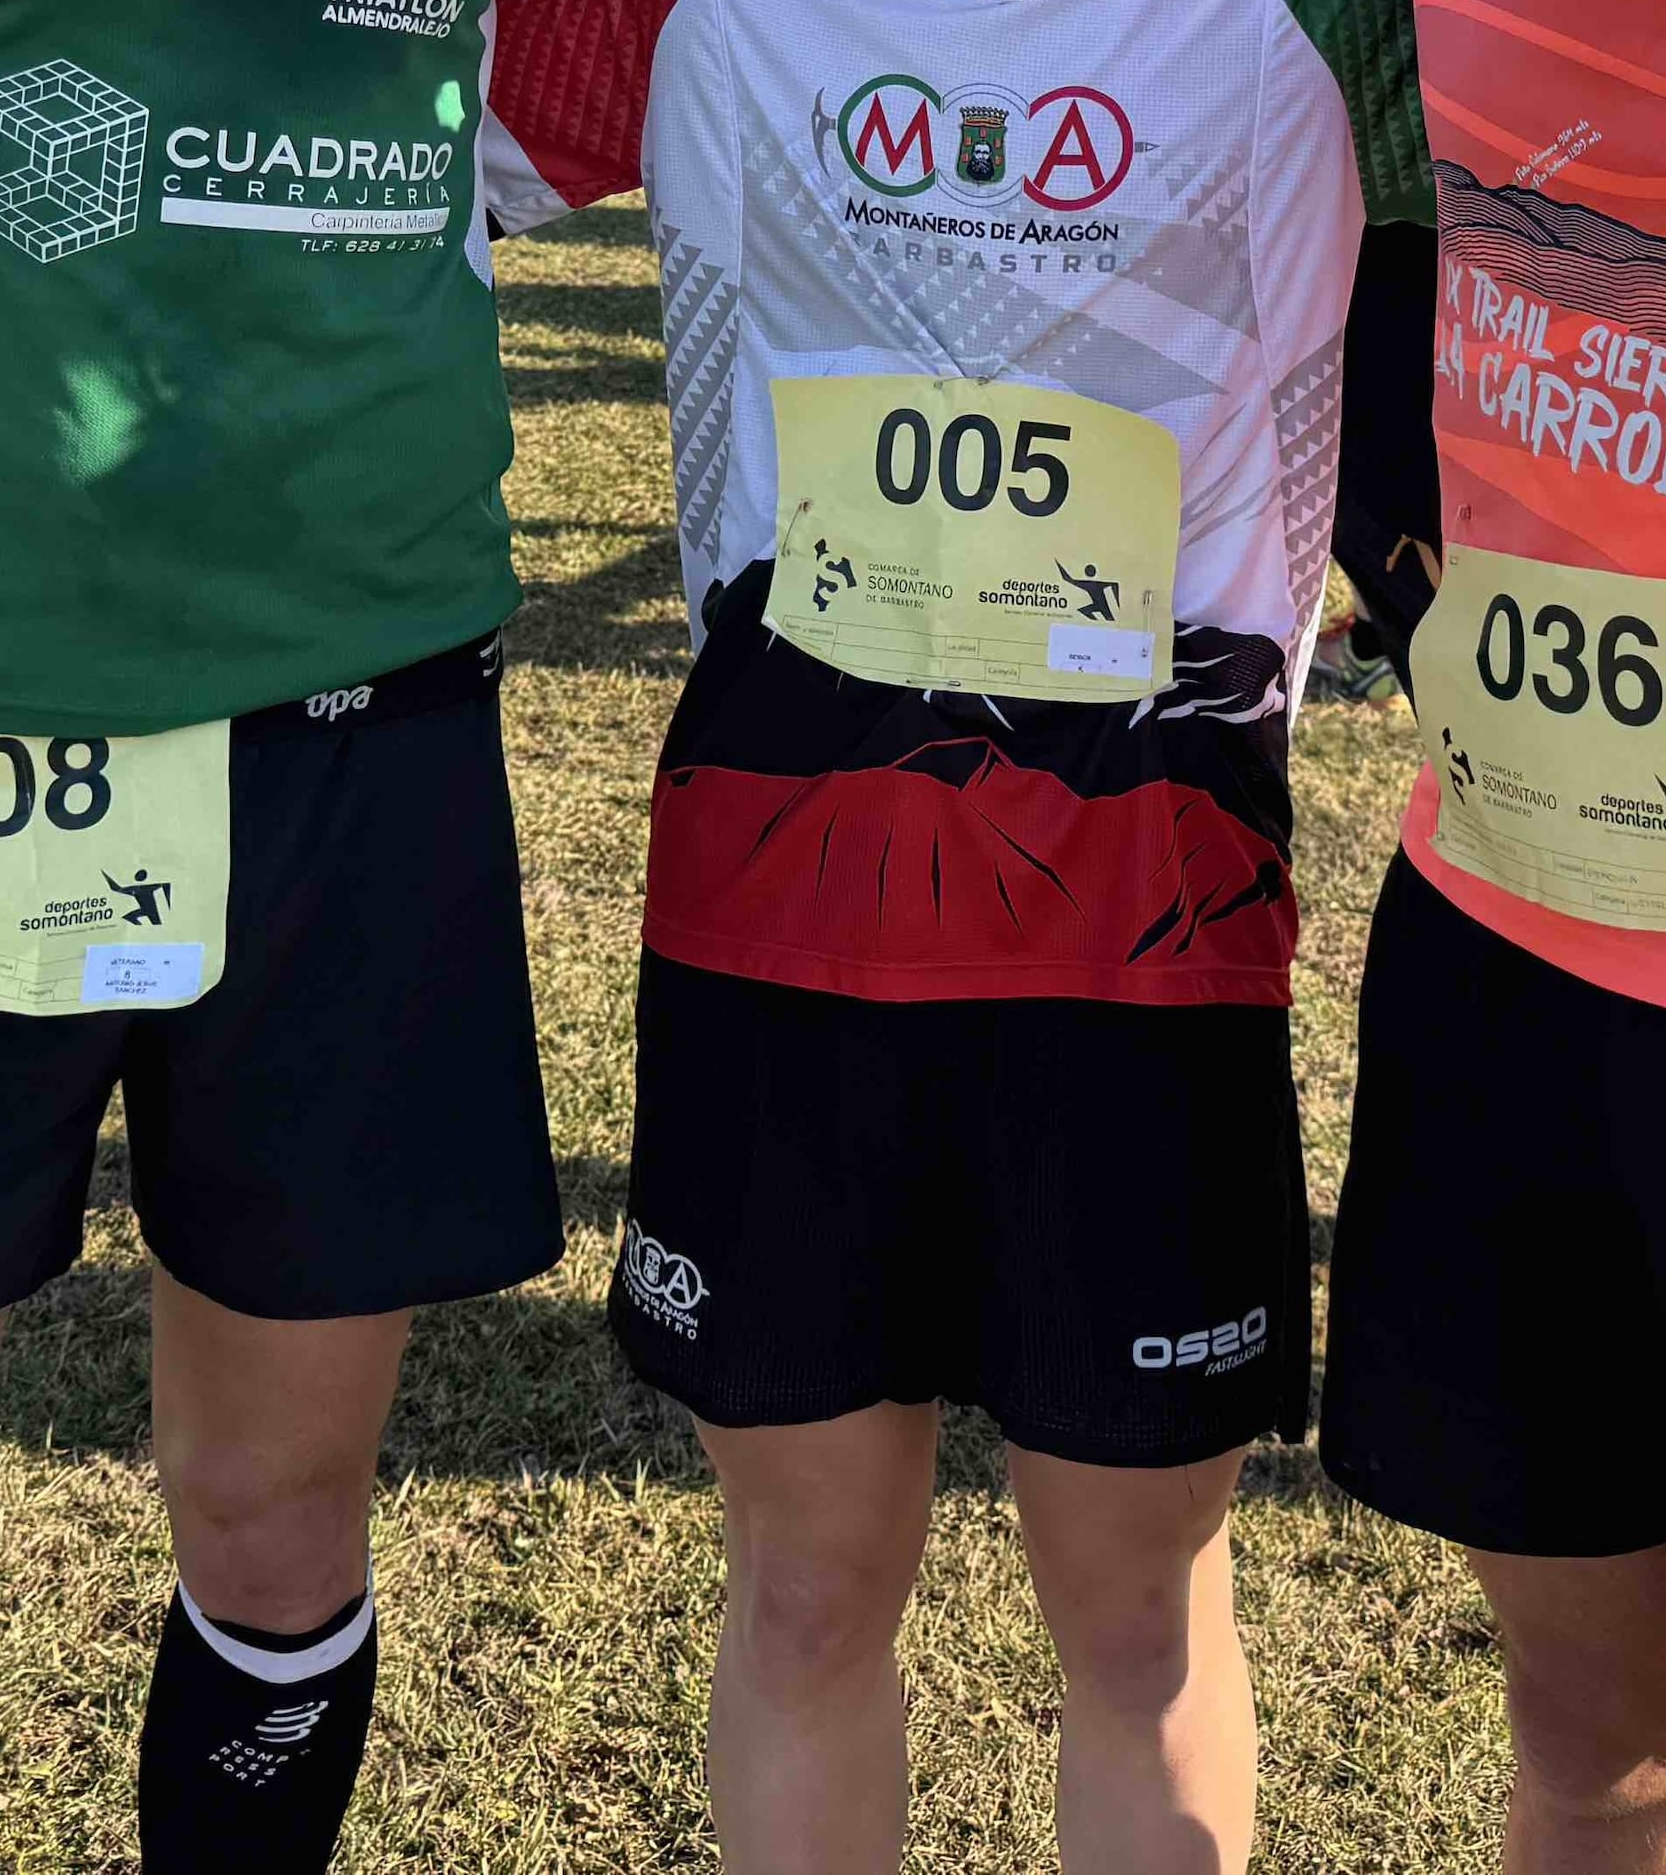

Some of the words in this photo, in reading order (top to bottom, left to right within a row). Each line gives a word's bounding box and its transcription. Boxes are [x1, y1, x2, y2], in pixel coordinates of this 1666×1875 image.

[322, 4, 451, 39] ALMENDRALEJO
[166, 126, 454, 182] CUADRADO
[162, 173, 451, 206] CERRAJERÍA
[989, 222, 1016, 241] DE
[301, 239, 338, 253] TLF:
[344, 239, 382, 253] 628
[1468, 266, 1556, 363] TRAIL
[875, 408, 1072, 517] 005
[867, 575, 954, 600] SOMONTANO
[978, 590, 1068, 610] somontano
[1002, 579, 1061, 596] deportes
[1476, 593, 1664, 727] 036
[1482, 773, 1558, 811] SOMONTANO
[1600, 792, 1664, 815] deportes
[44, 896, 108, 916] deportes
[20, 907, 114, 932] somontano
